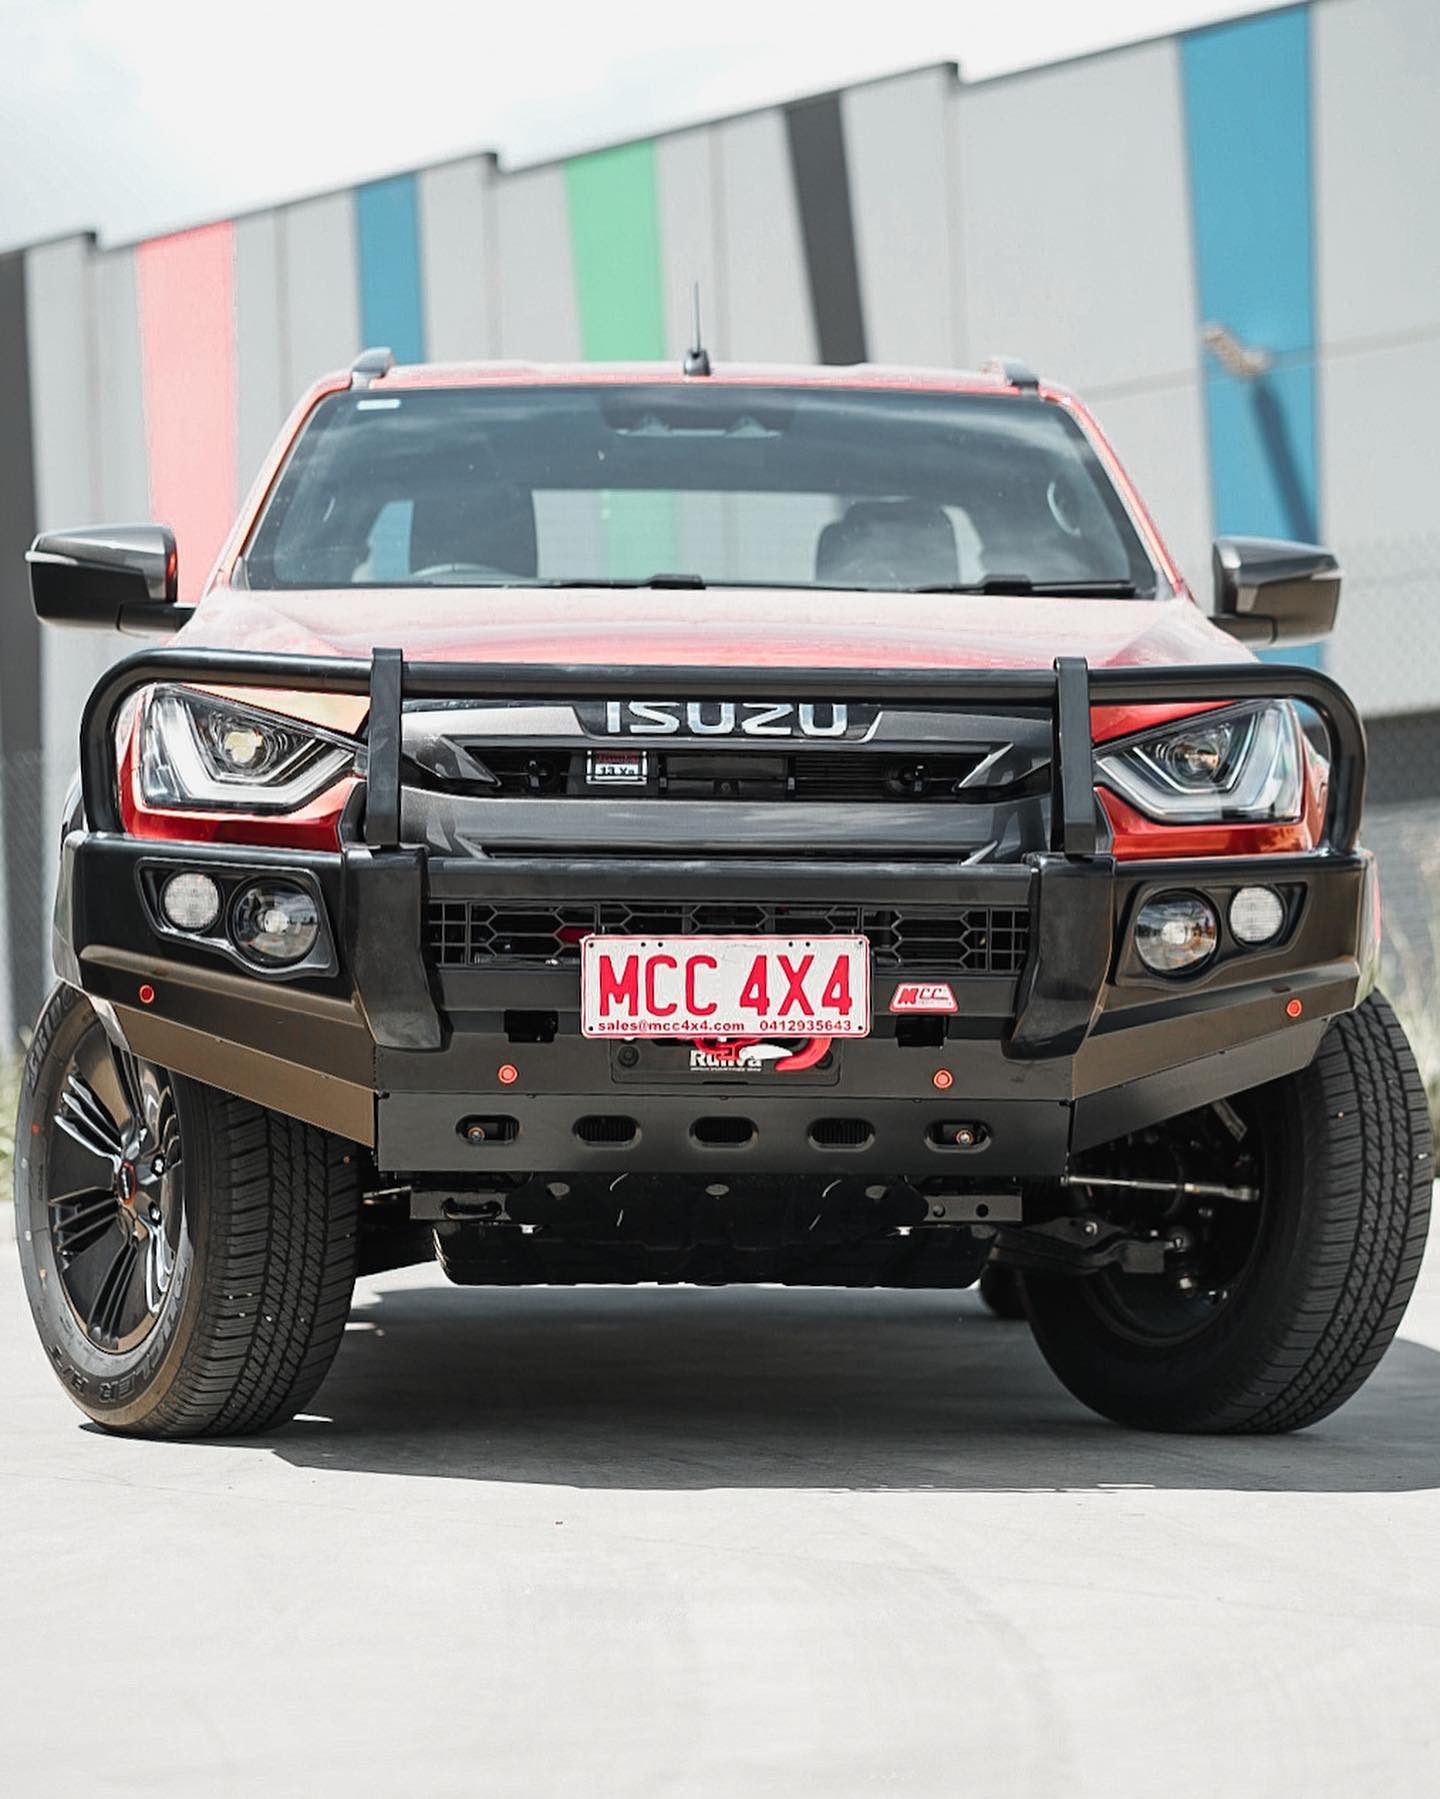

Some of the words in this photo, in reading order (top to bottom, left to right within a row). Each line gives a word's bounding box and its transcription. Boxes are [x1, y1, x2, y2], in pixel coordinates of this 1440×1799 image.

[605, 700, 849, 736] ISUZU
[598, 954, 718, 1018] MCC
[738, 954, 854, 1018] 4X4
[897, 987, 950, 1005] MCC
[598, 1019, 745, 1033] sales@mcc4x4.com
[758, 1020, 853, 1033] 0412935643
